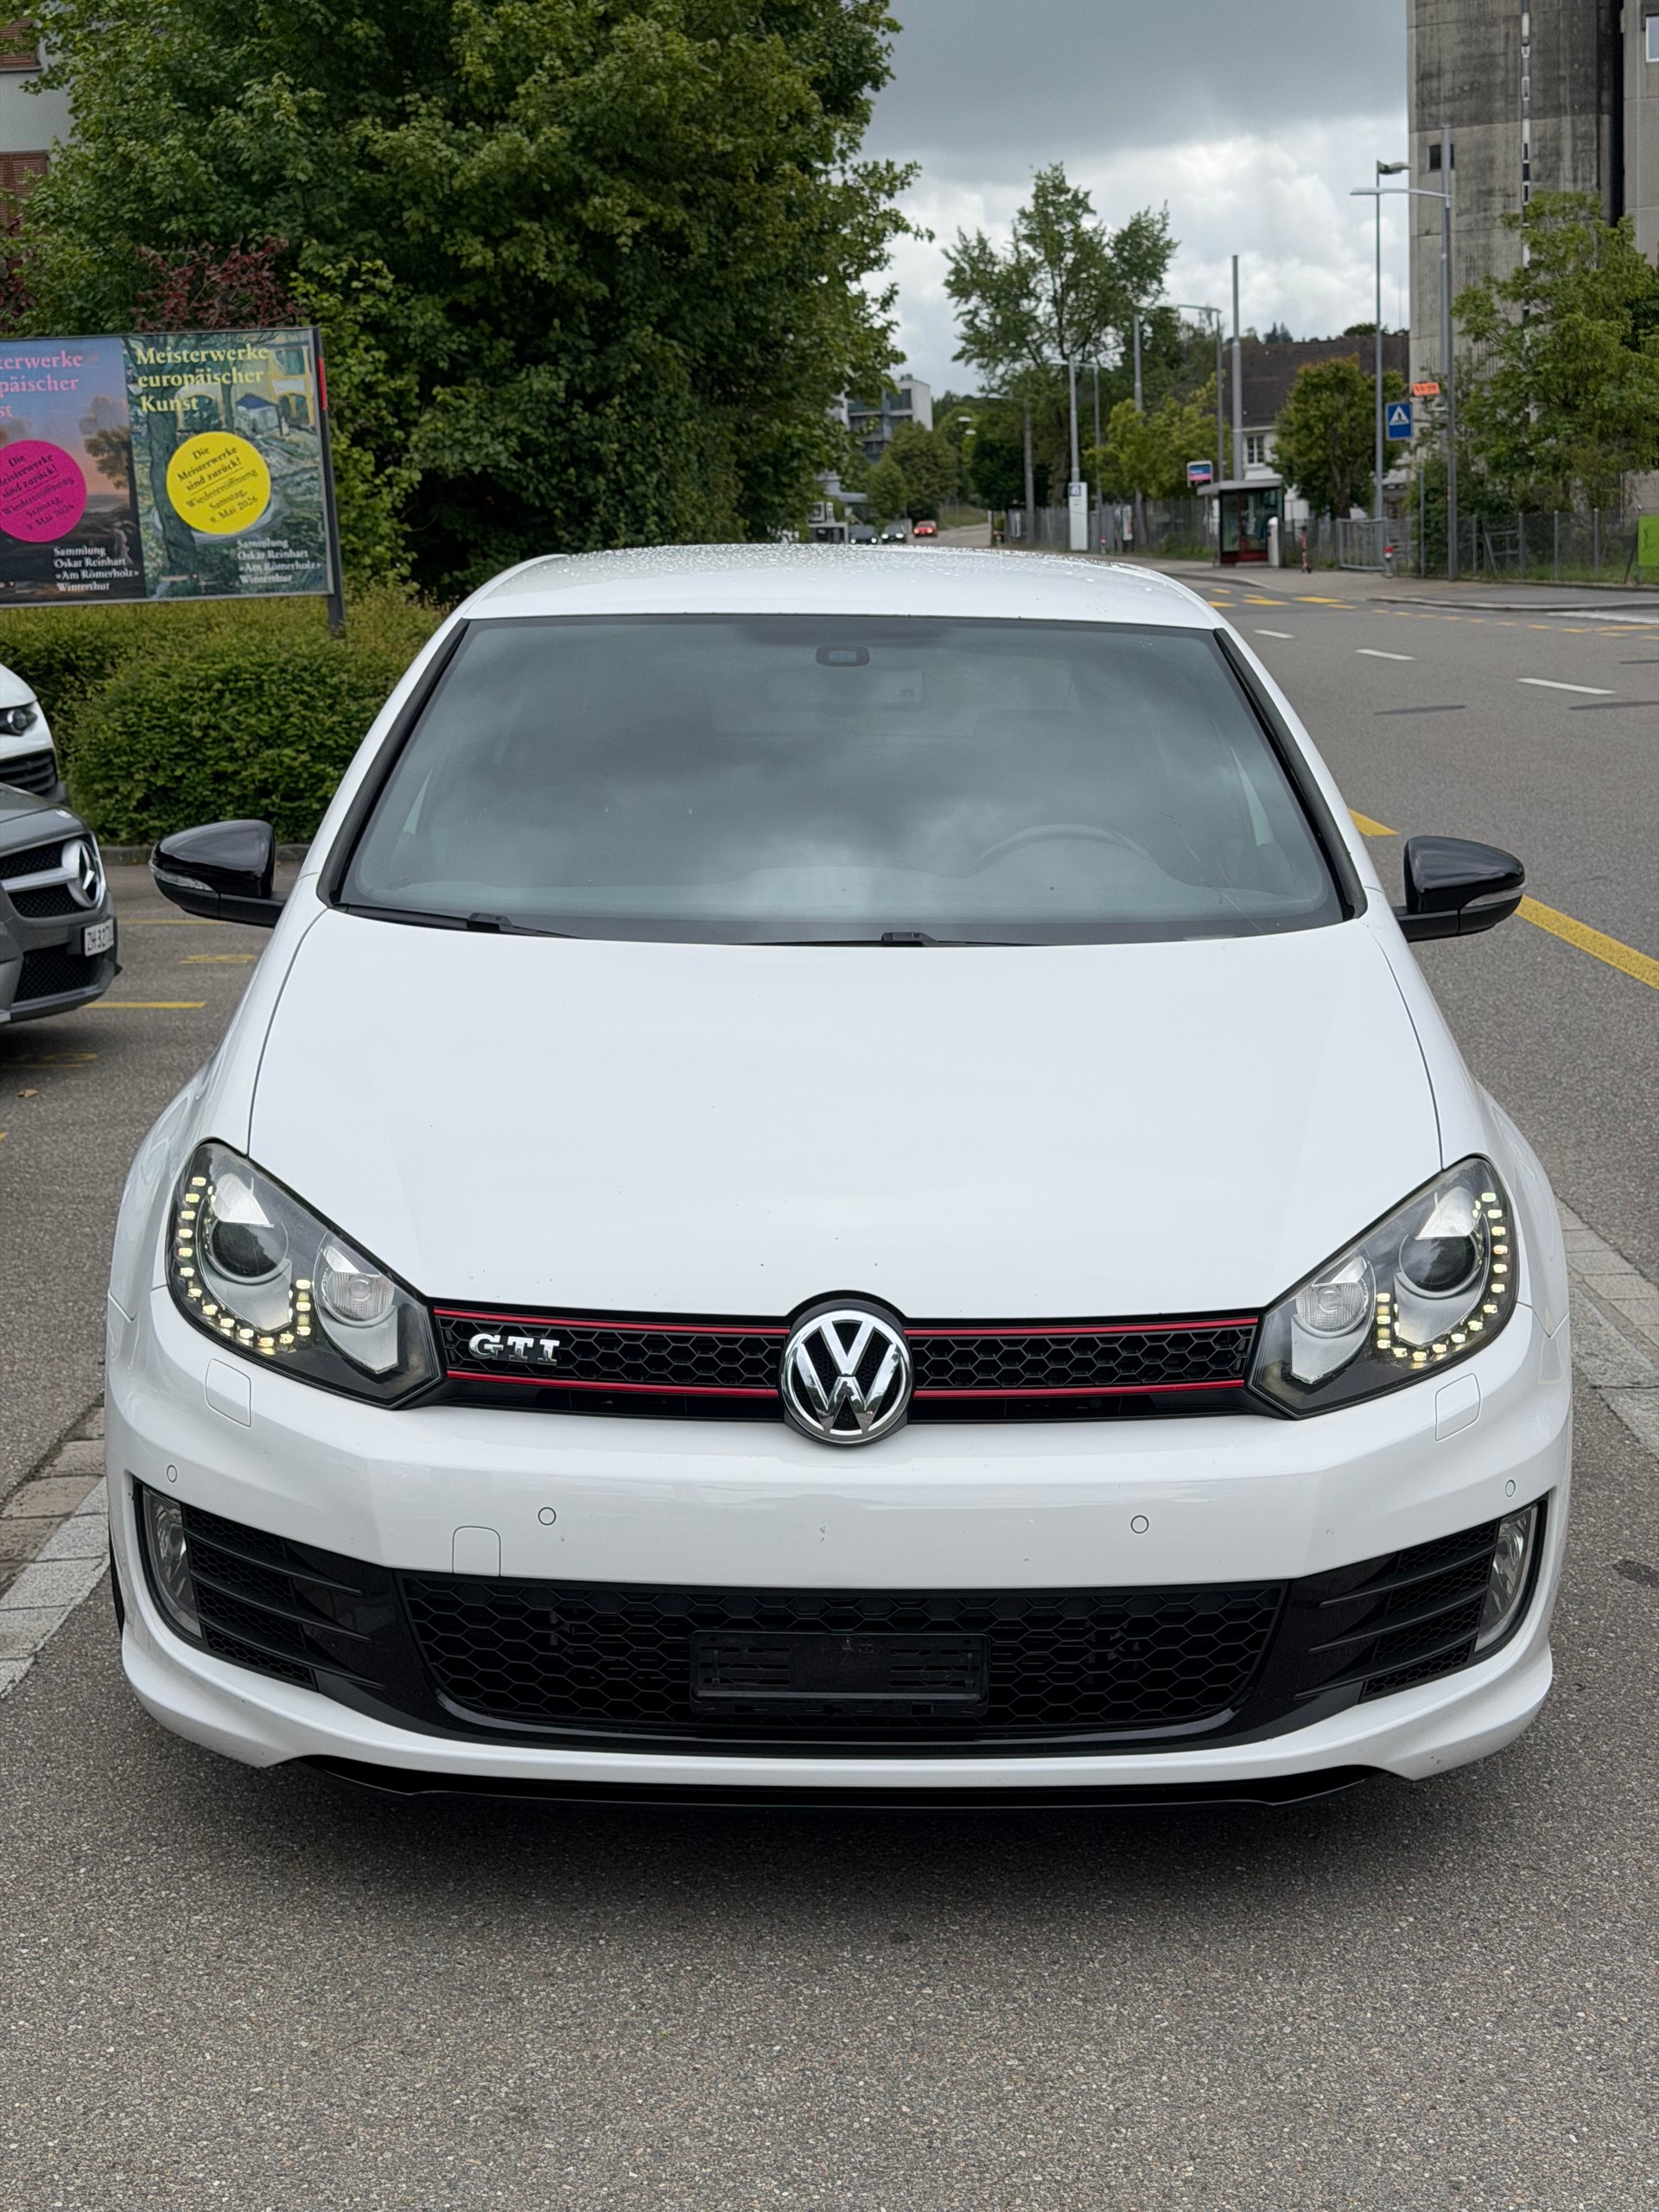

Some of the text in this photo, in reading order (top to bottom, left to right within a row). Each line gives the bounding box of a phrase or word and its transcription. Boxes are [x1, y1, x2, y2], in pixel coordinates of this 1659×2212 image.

[136, 342, 270, 365] Meisterwerke
[137, 366, 265, 389] europäischer
[140, 395, 200, 413] Kunst
[193, 448, 210, 460] Die
[177, 447, 238, 481] Meisterwerke
[54, 544, 106, 557] Sammlung
[237, 537, 289, 550] Sammlung
[54, 556, 126, 569] Oskar Reinhart
[237, 550, 309, 561] Oskar Reinhart
[468, 1333, 560, 1365] GTI
